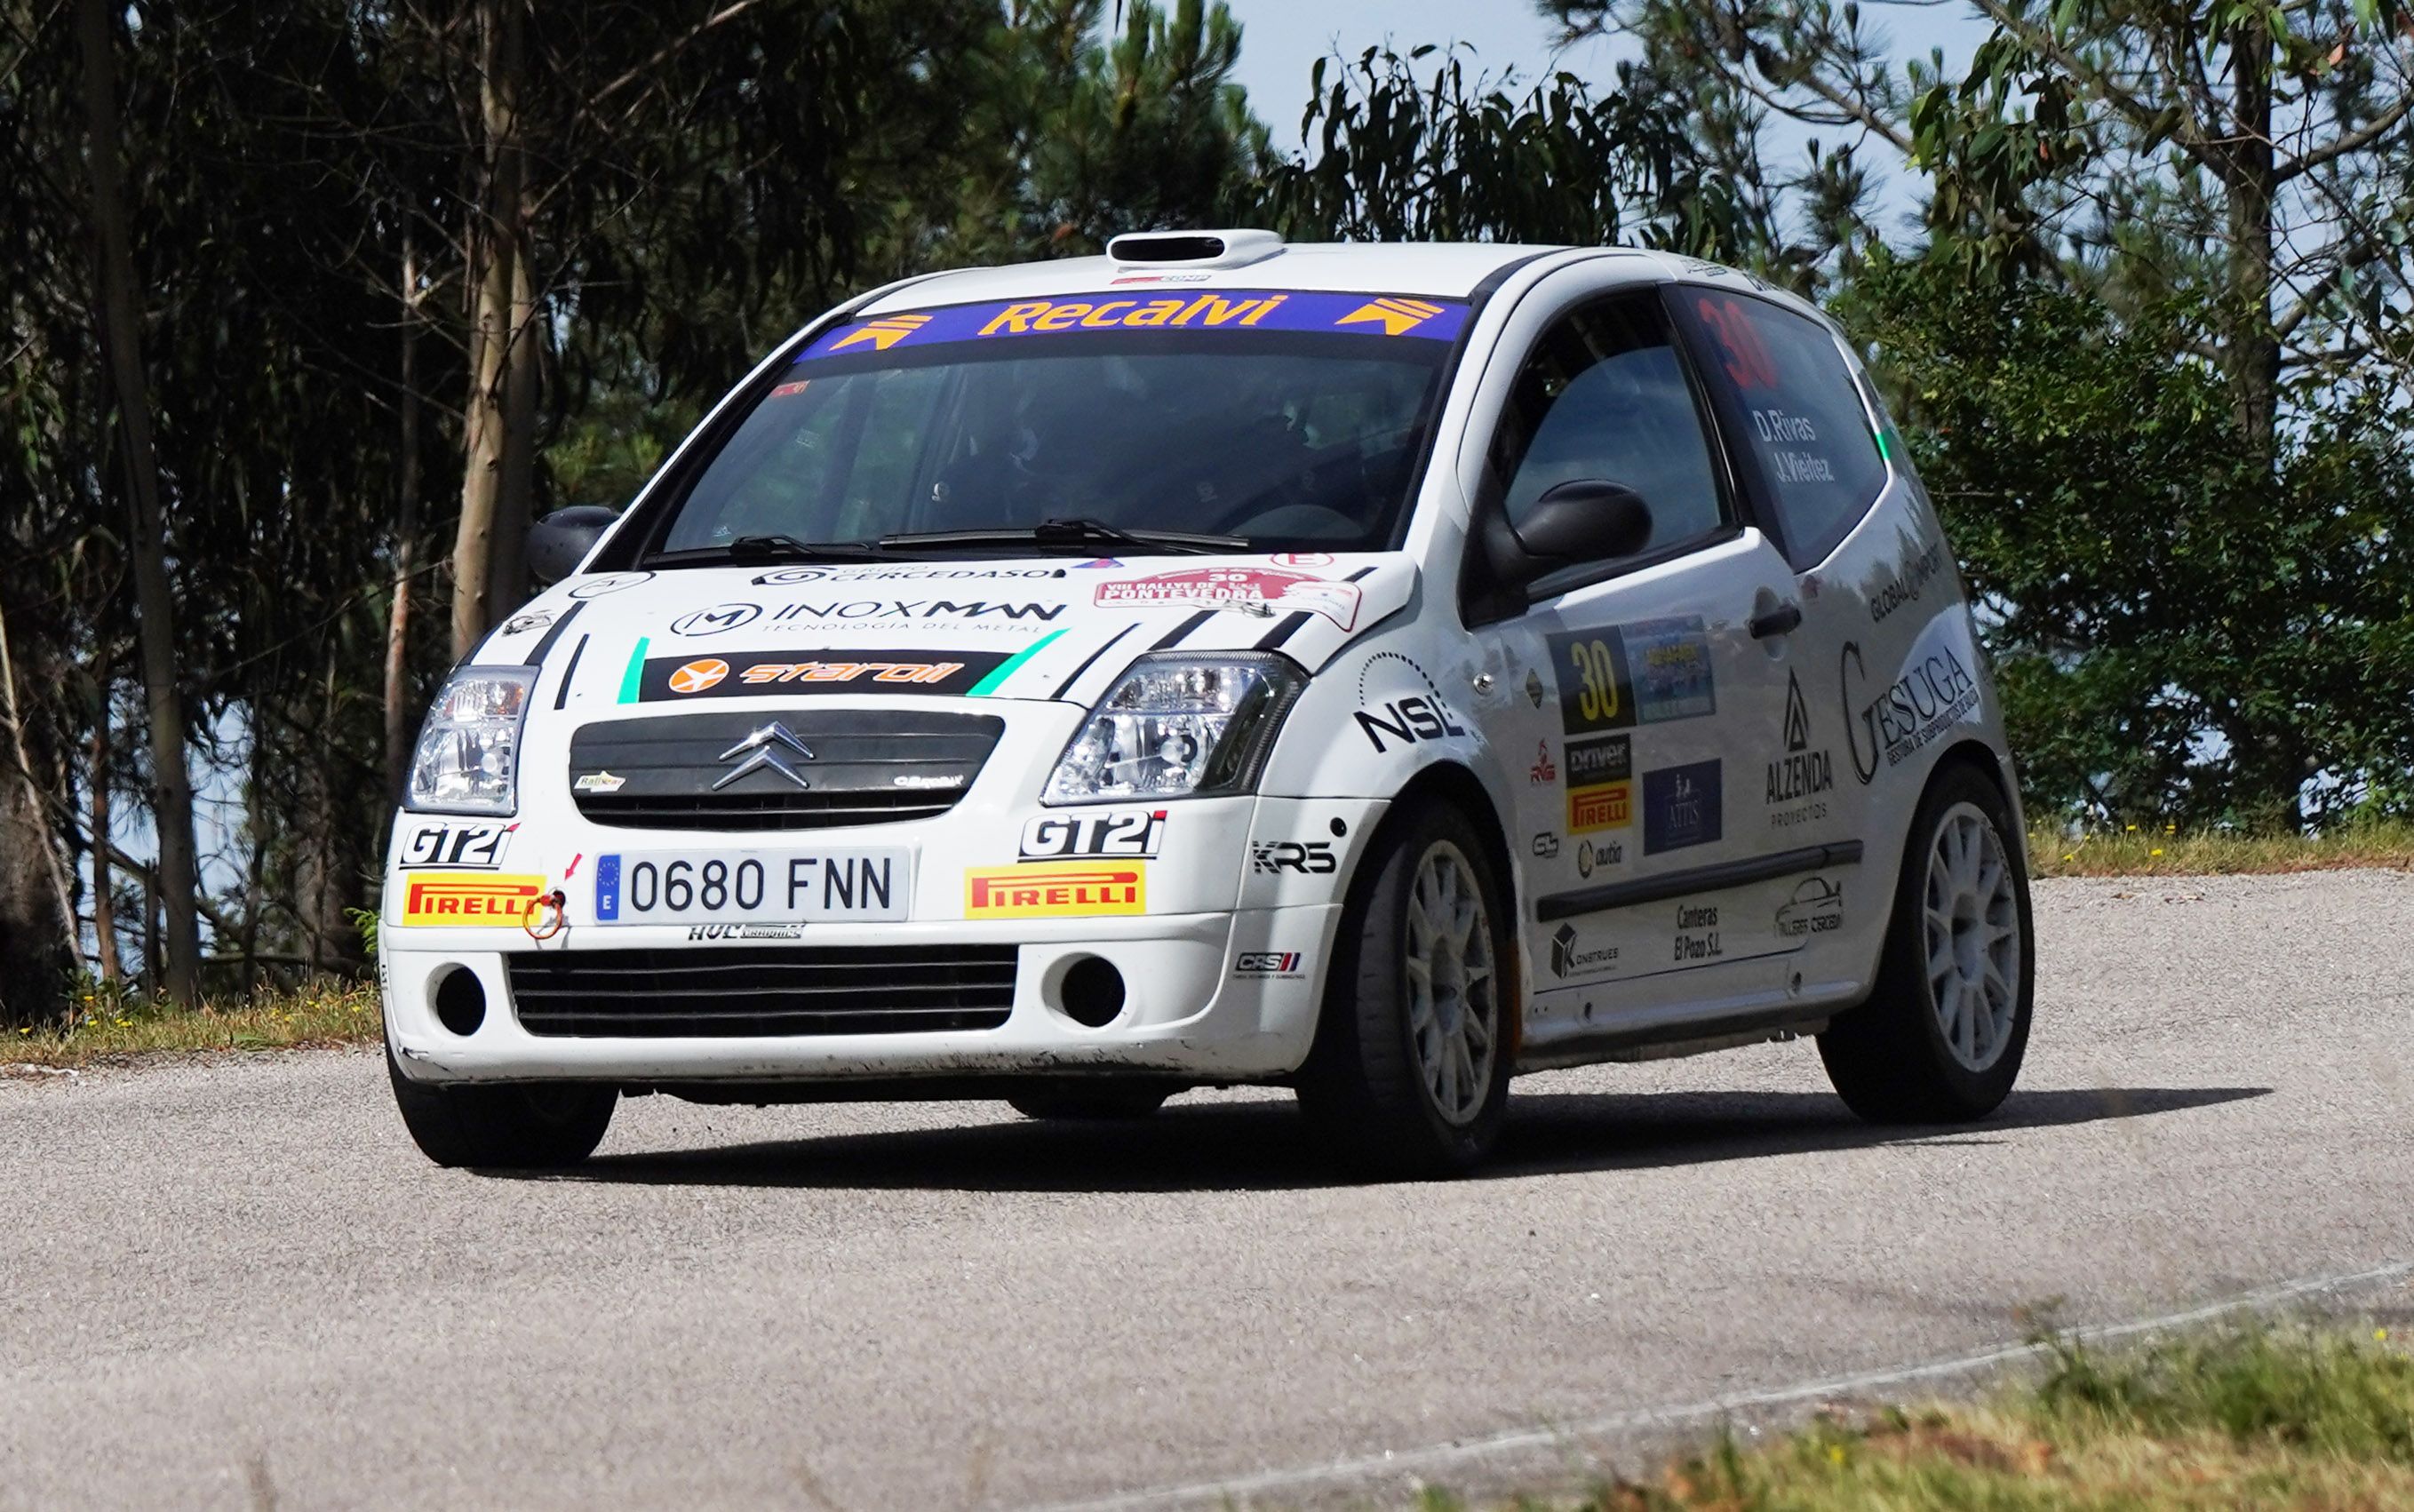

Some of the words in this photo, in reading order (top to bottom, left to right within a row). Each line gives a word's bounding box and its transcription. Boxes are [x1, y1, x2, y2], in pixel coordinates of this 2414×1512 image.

[977, 294, 1288, 337] Recalvi
[1698, 298, 1778, 390] 30
[1103, 587, 1263, 601] PONTEVEDRA
[1208, 573, 1248, 583] 30
[772, 601, 1068, 621] INOXMAN
[922, 623, 960, 632] DEL
[973, 624, 1040, 634] METAL
[1571, 640, 1619, 721] 30
[1766, 749, 1833, 805] ALZENDA
[1573, 788, 1628, 828] PIRELLI
[409, 883, 539, 915] PIRELLI
[631, 858, 765, 913] 0680
[787, 856, 892, 911] FNN
[971, 872, 1139, 908] PIRELLI
[602, 895, 612, 911] E
[1677, 904, 1718, 929] Canteras
